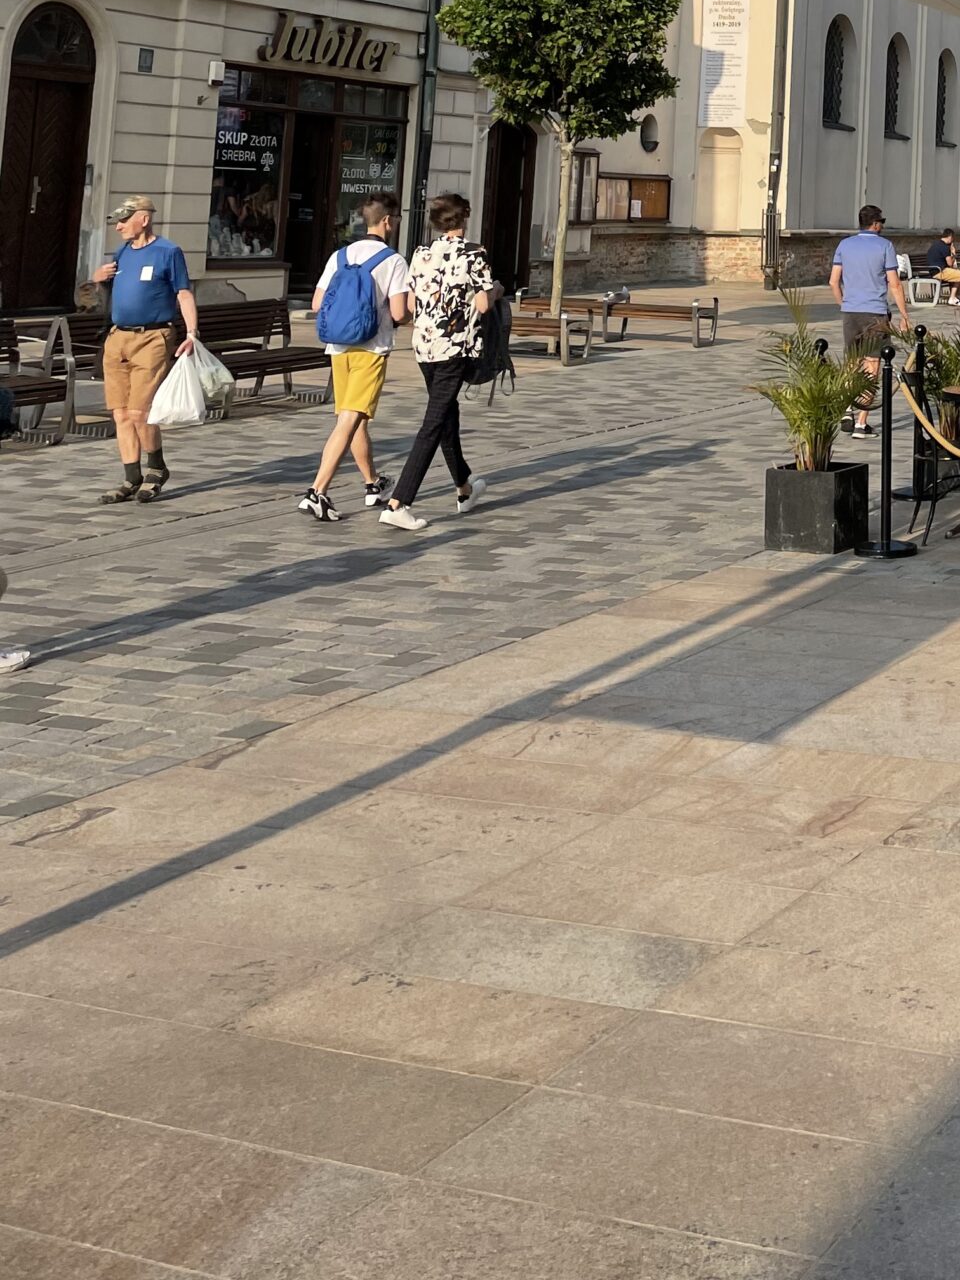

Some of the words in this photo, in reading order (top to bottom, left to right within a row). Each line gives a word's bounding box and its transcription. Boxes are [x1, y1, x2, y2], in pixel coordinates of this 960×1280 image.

[259, 11, 400, 71] Jubiler
[217, 130, 248, 145] SKUP
[249, 135, 278, 147] ZŁOTA
[221, 149, 257, 162] SREBRA
[342, 167, 366, 179] ZŁOTO
